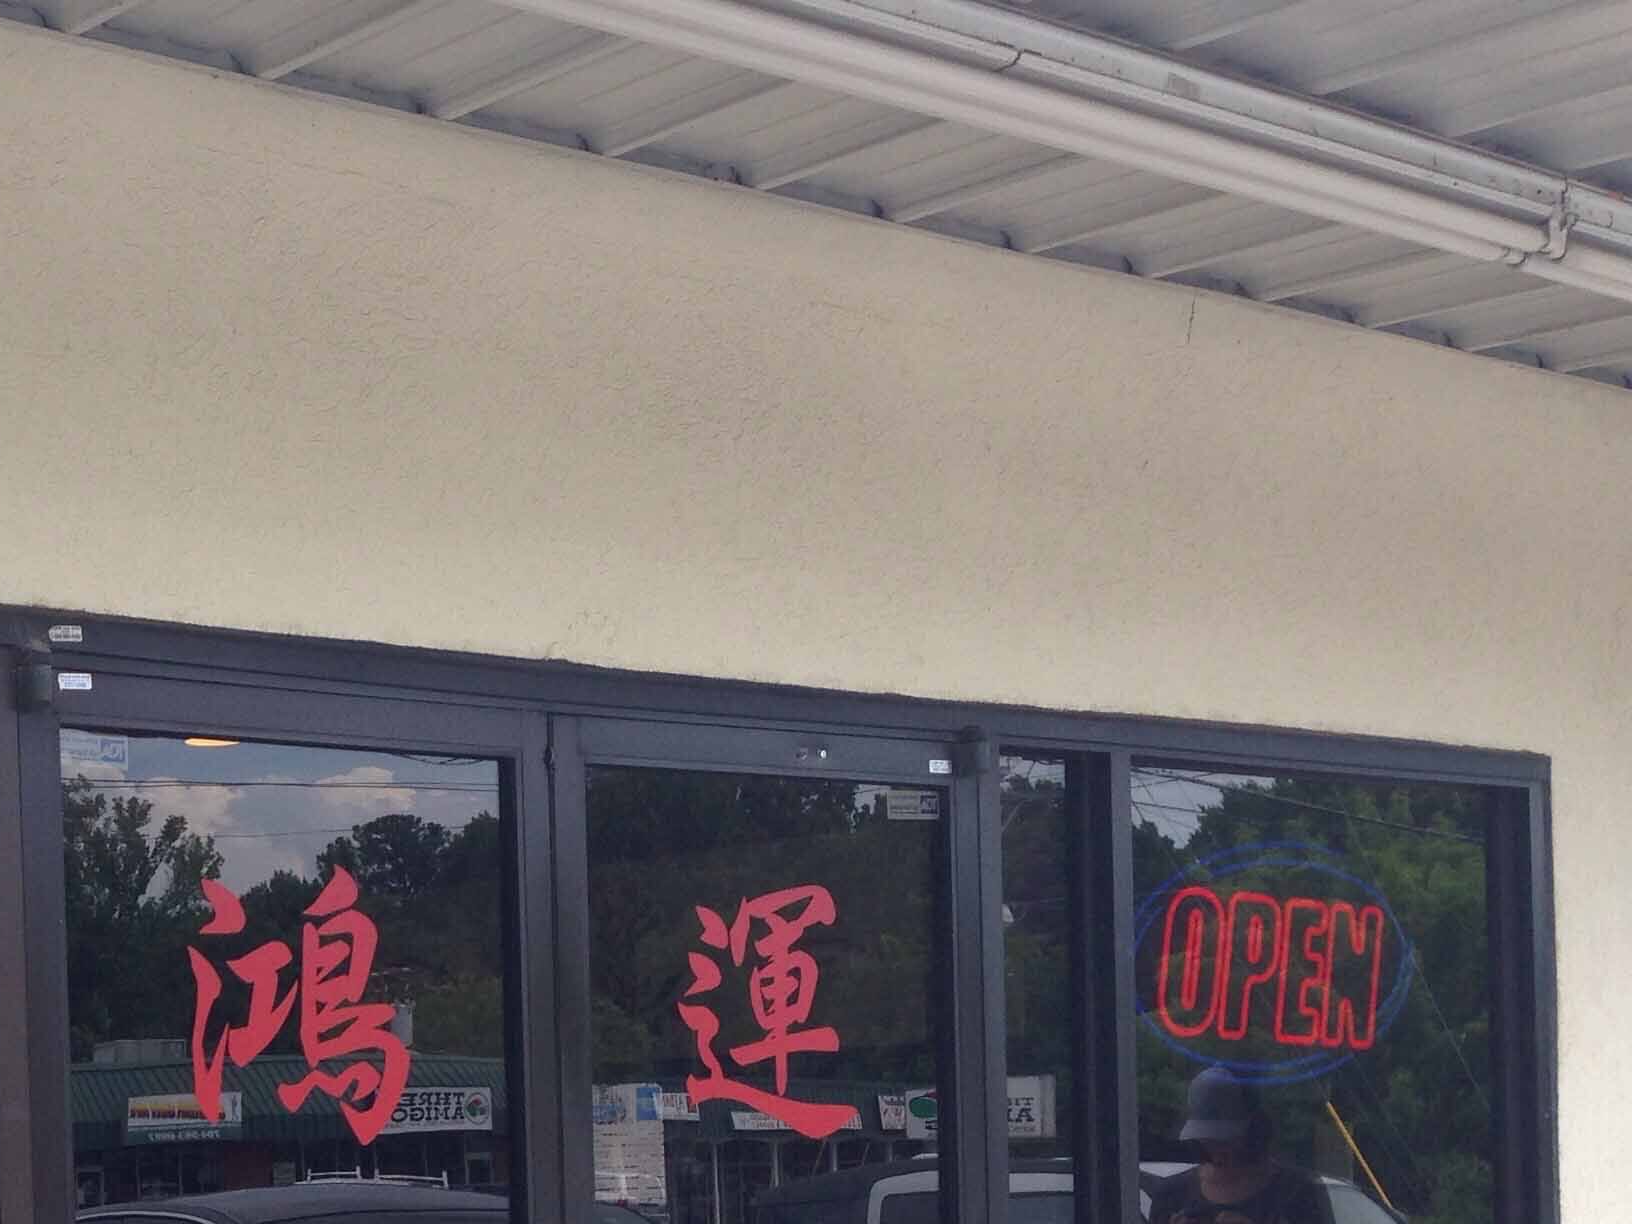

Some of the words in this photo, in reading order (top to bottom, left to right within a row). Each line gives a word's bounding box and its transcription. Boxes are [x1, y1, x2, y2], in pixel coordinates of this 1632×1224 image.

[187, 864, 411, 1146] 鴻
[677, 884, 863, 1140] 運
[1157, 886, 1384, 1050] OPEN
